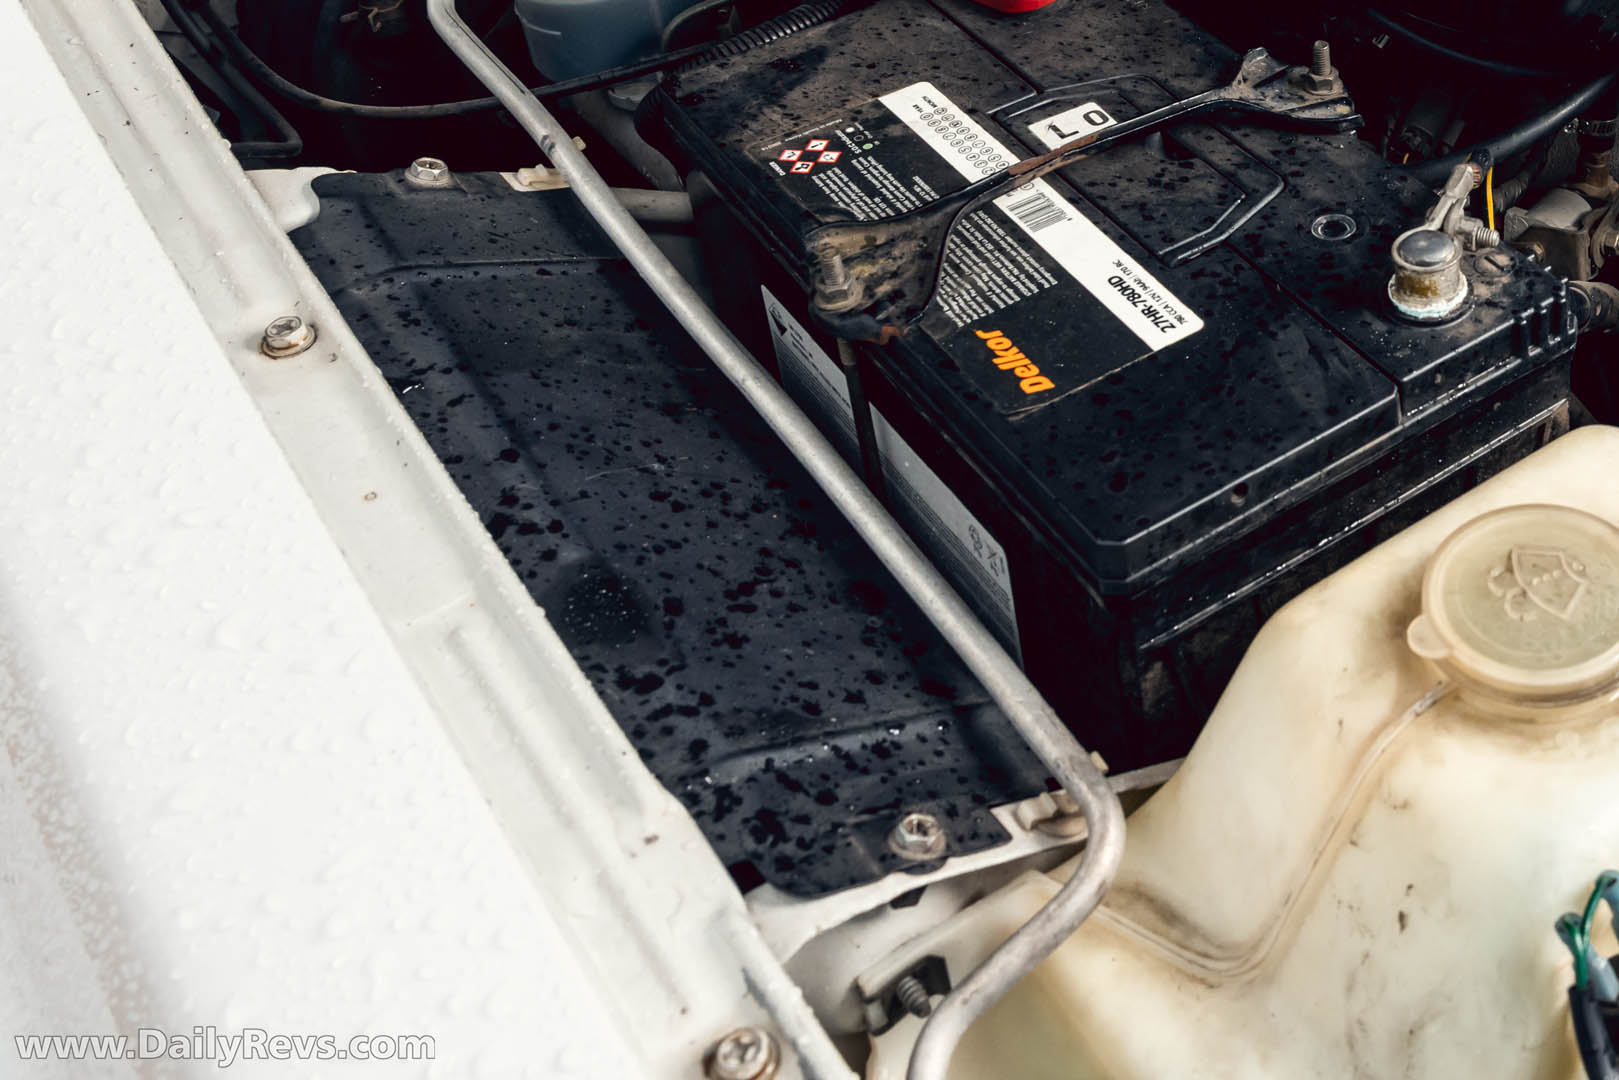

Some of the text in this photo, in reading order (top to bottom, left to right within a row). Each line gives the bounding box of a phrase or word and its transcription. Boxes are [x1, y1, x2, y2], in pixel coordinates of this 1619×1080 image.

[921, 94, 938, 108] MONTH
[911, 103, 925, 113] YEAR
[767, 160, 787, 176] DANGER
[1111, 258, 1124, 268] RC
[1119, 265, 1134, 276] 170
[1131, 276, 1150, 291] 94Ah
[1148, 291, 1163, 302] 12V
[1103, 273, 1177, 334] 27HR-780HD
[1161, 303, 1178, 316] CCA
[974, 328, 1054, 395] Delkor
